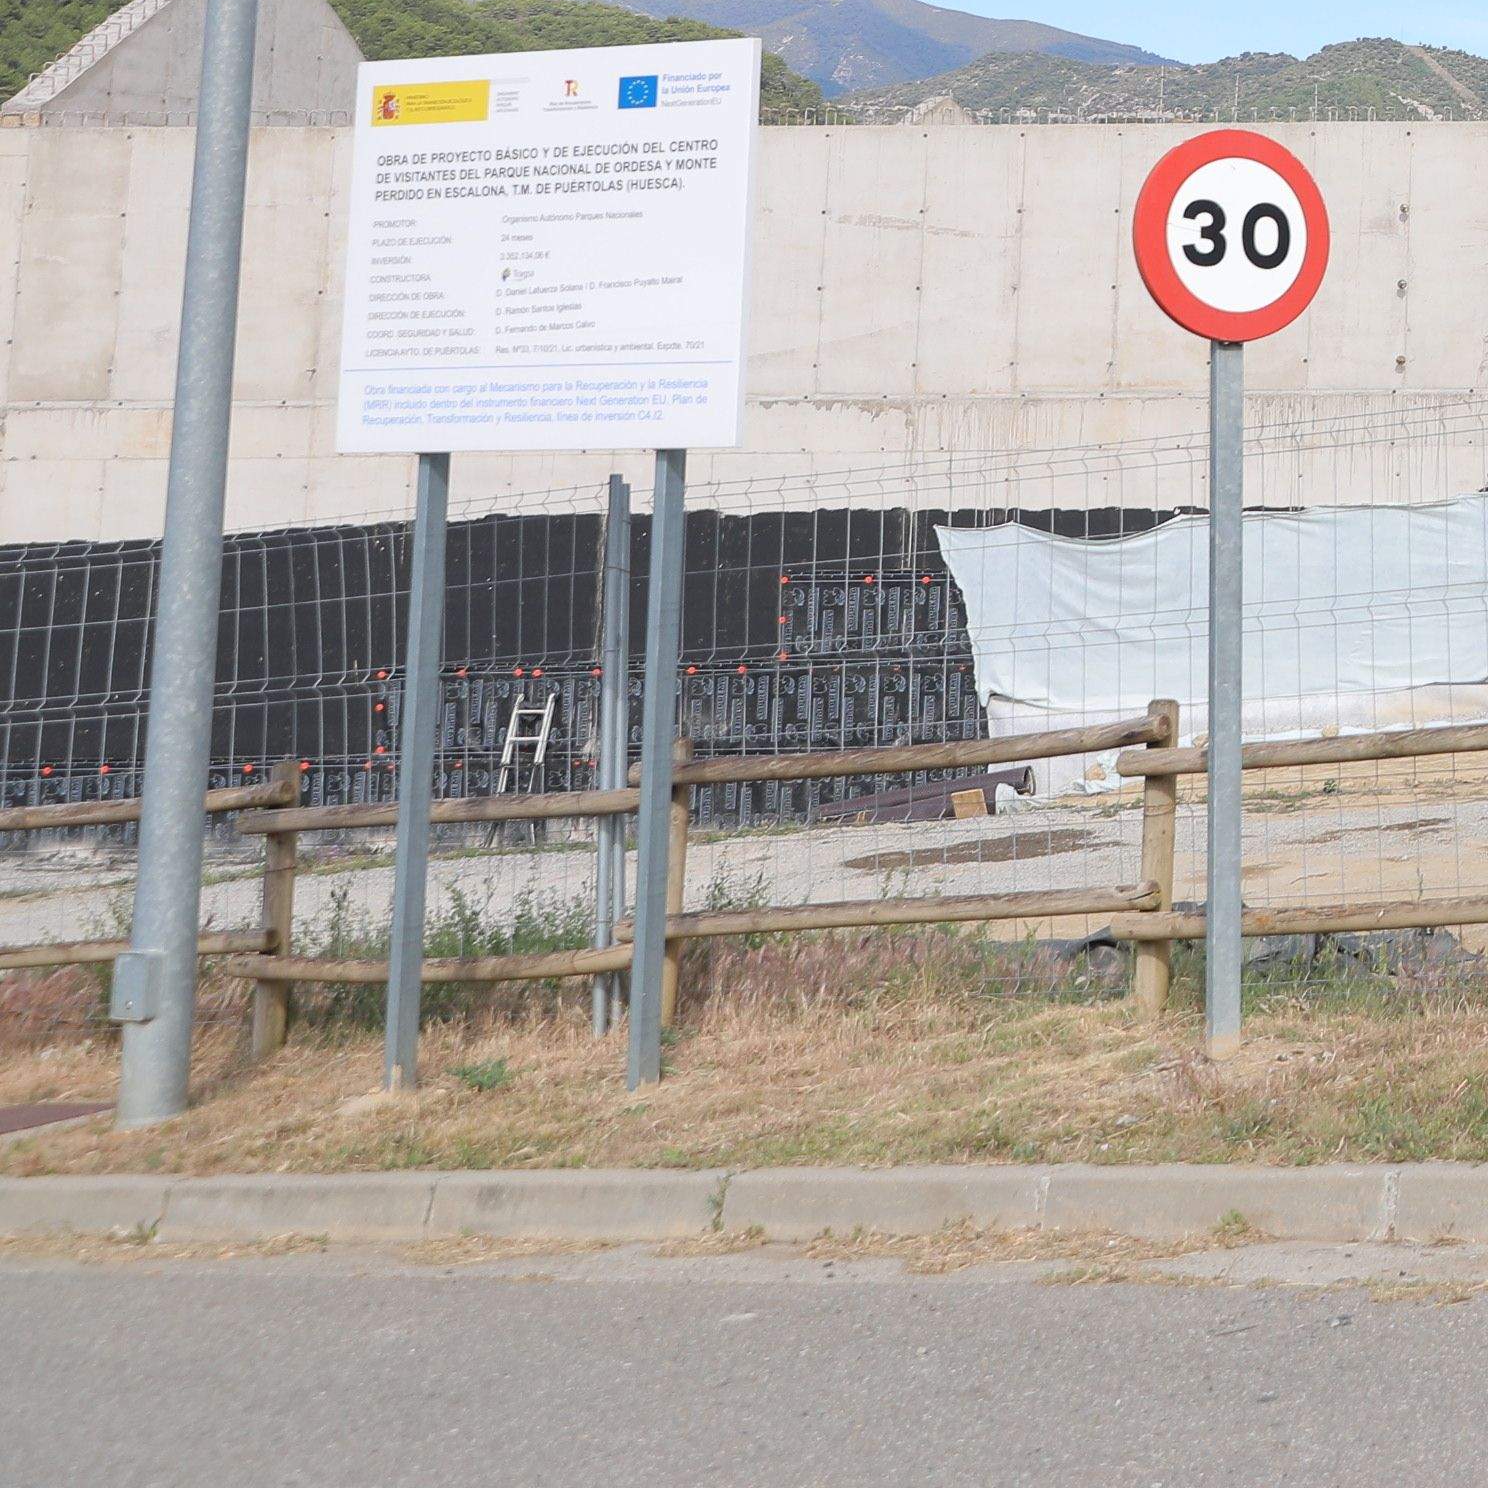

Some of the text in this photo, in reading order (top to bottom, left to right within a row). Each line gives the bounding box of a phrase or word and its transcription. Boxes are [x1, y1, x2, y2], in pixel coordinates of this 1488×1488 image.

[662, 83, 730, 94] la Unión Europea
[663, 72, 722, 82] Financiado por
[377, 141, 718, 166] OBRA DE PROYECTO BÁSICO Y DE EJECUCIÓN DEL CENTRO
[376, 158, 717, 183] DE VISITANTES DEL PARQUE NACIONAL DE ORDESA Y MONTE
[375, 189, 423, 201] PERDIDO
[427, 188, 442, 199] EN
[536, 184, 551, 195] DE
[555, 179, 623, 194] PUÉRTOLAS
[1182, 199, 1290, 269] 30
